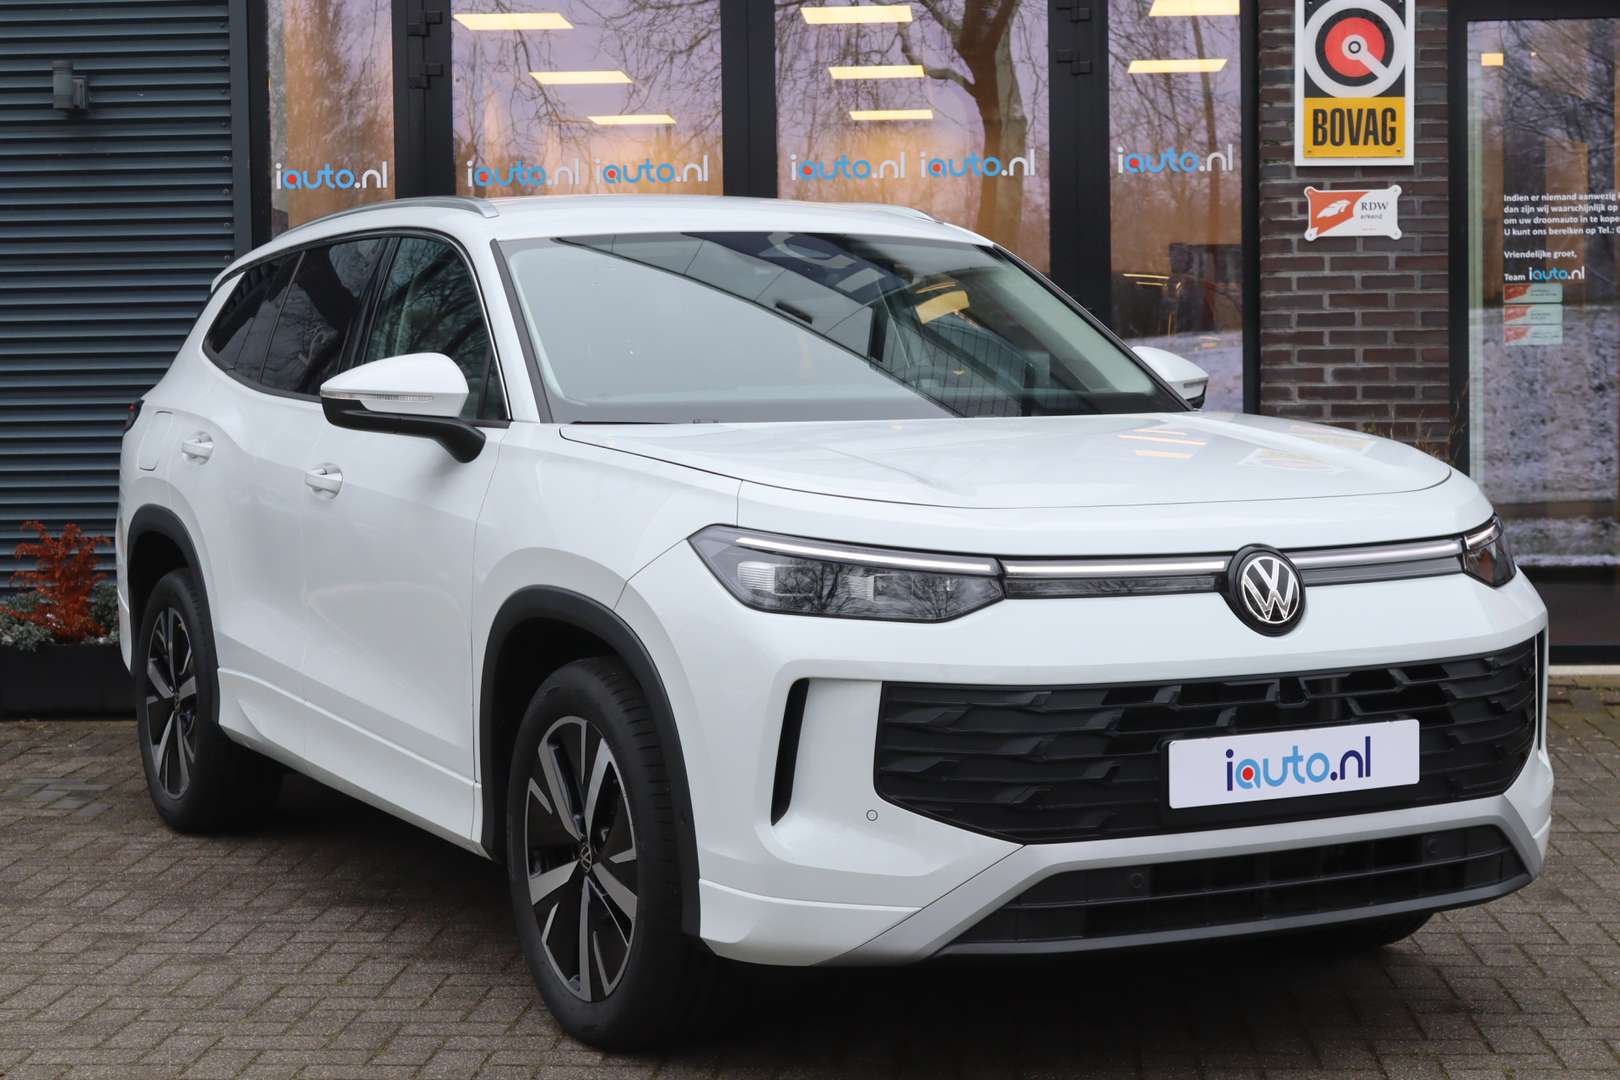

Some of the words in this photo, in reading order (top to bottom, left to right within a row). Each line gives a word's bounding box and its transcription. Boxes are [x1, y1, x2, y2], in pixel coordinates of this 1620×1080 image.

[1312, 107, 1397, 147] BOVAG
[466, 158, 580, 188] iauto.nl
[594, 154, 709, 184] iauto.nl
[789, 151, 907, 181] iauto.nl
[919, 148, 1036, 179] iauto.nl
[1117, 143, 1233, 174] iauto.nl
[275, 160, 388, 190] iauto.nl
[1361, 201, 1387, 211] RDW
[1503, 194, 1529, 202] Indien
[1541, 193, 1577, 201] niemand
[1578, 192, 1616, 202] aanwezig
[1503, 205, 1519, 214] dan
[1520, 205, 1535, 215] zijn
[1537, 205, 1550, 215] wij
[1550, 203, 1605, 214] waarschijnlijk
[1607, 205, 1618, 213] op
[1503, 228, 1511, 236] U
[1512, 228, 1531, 236] kunt
[1548, 227, 1584, 235] bereiken
[1585, 228, 1596, 236] op
[1533, 216, 1579, 224] droomauto
[1503, 249, 1552, 260] Vriendelijke
[1553, 250, 1578, 259] groet,
[1503, 273, 1526, 281] Team
[1528, 266, 1585, 281] iauto.nl
[1225, 735, 1372, 792] iauto.nl
